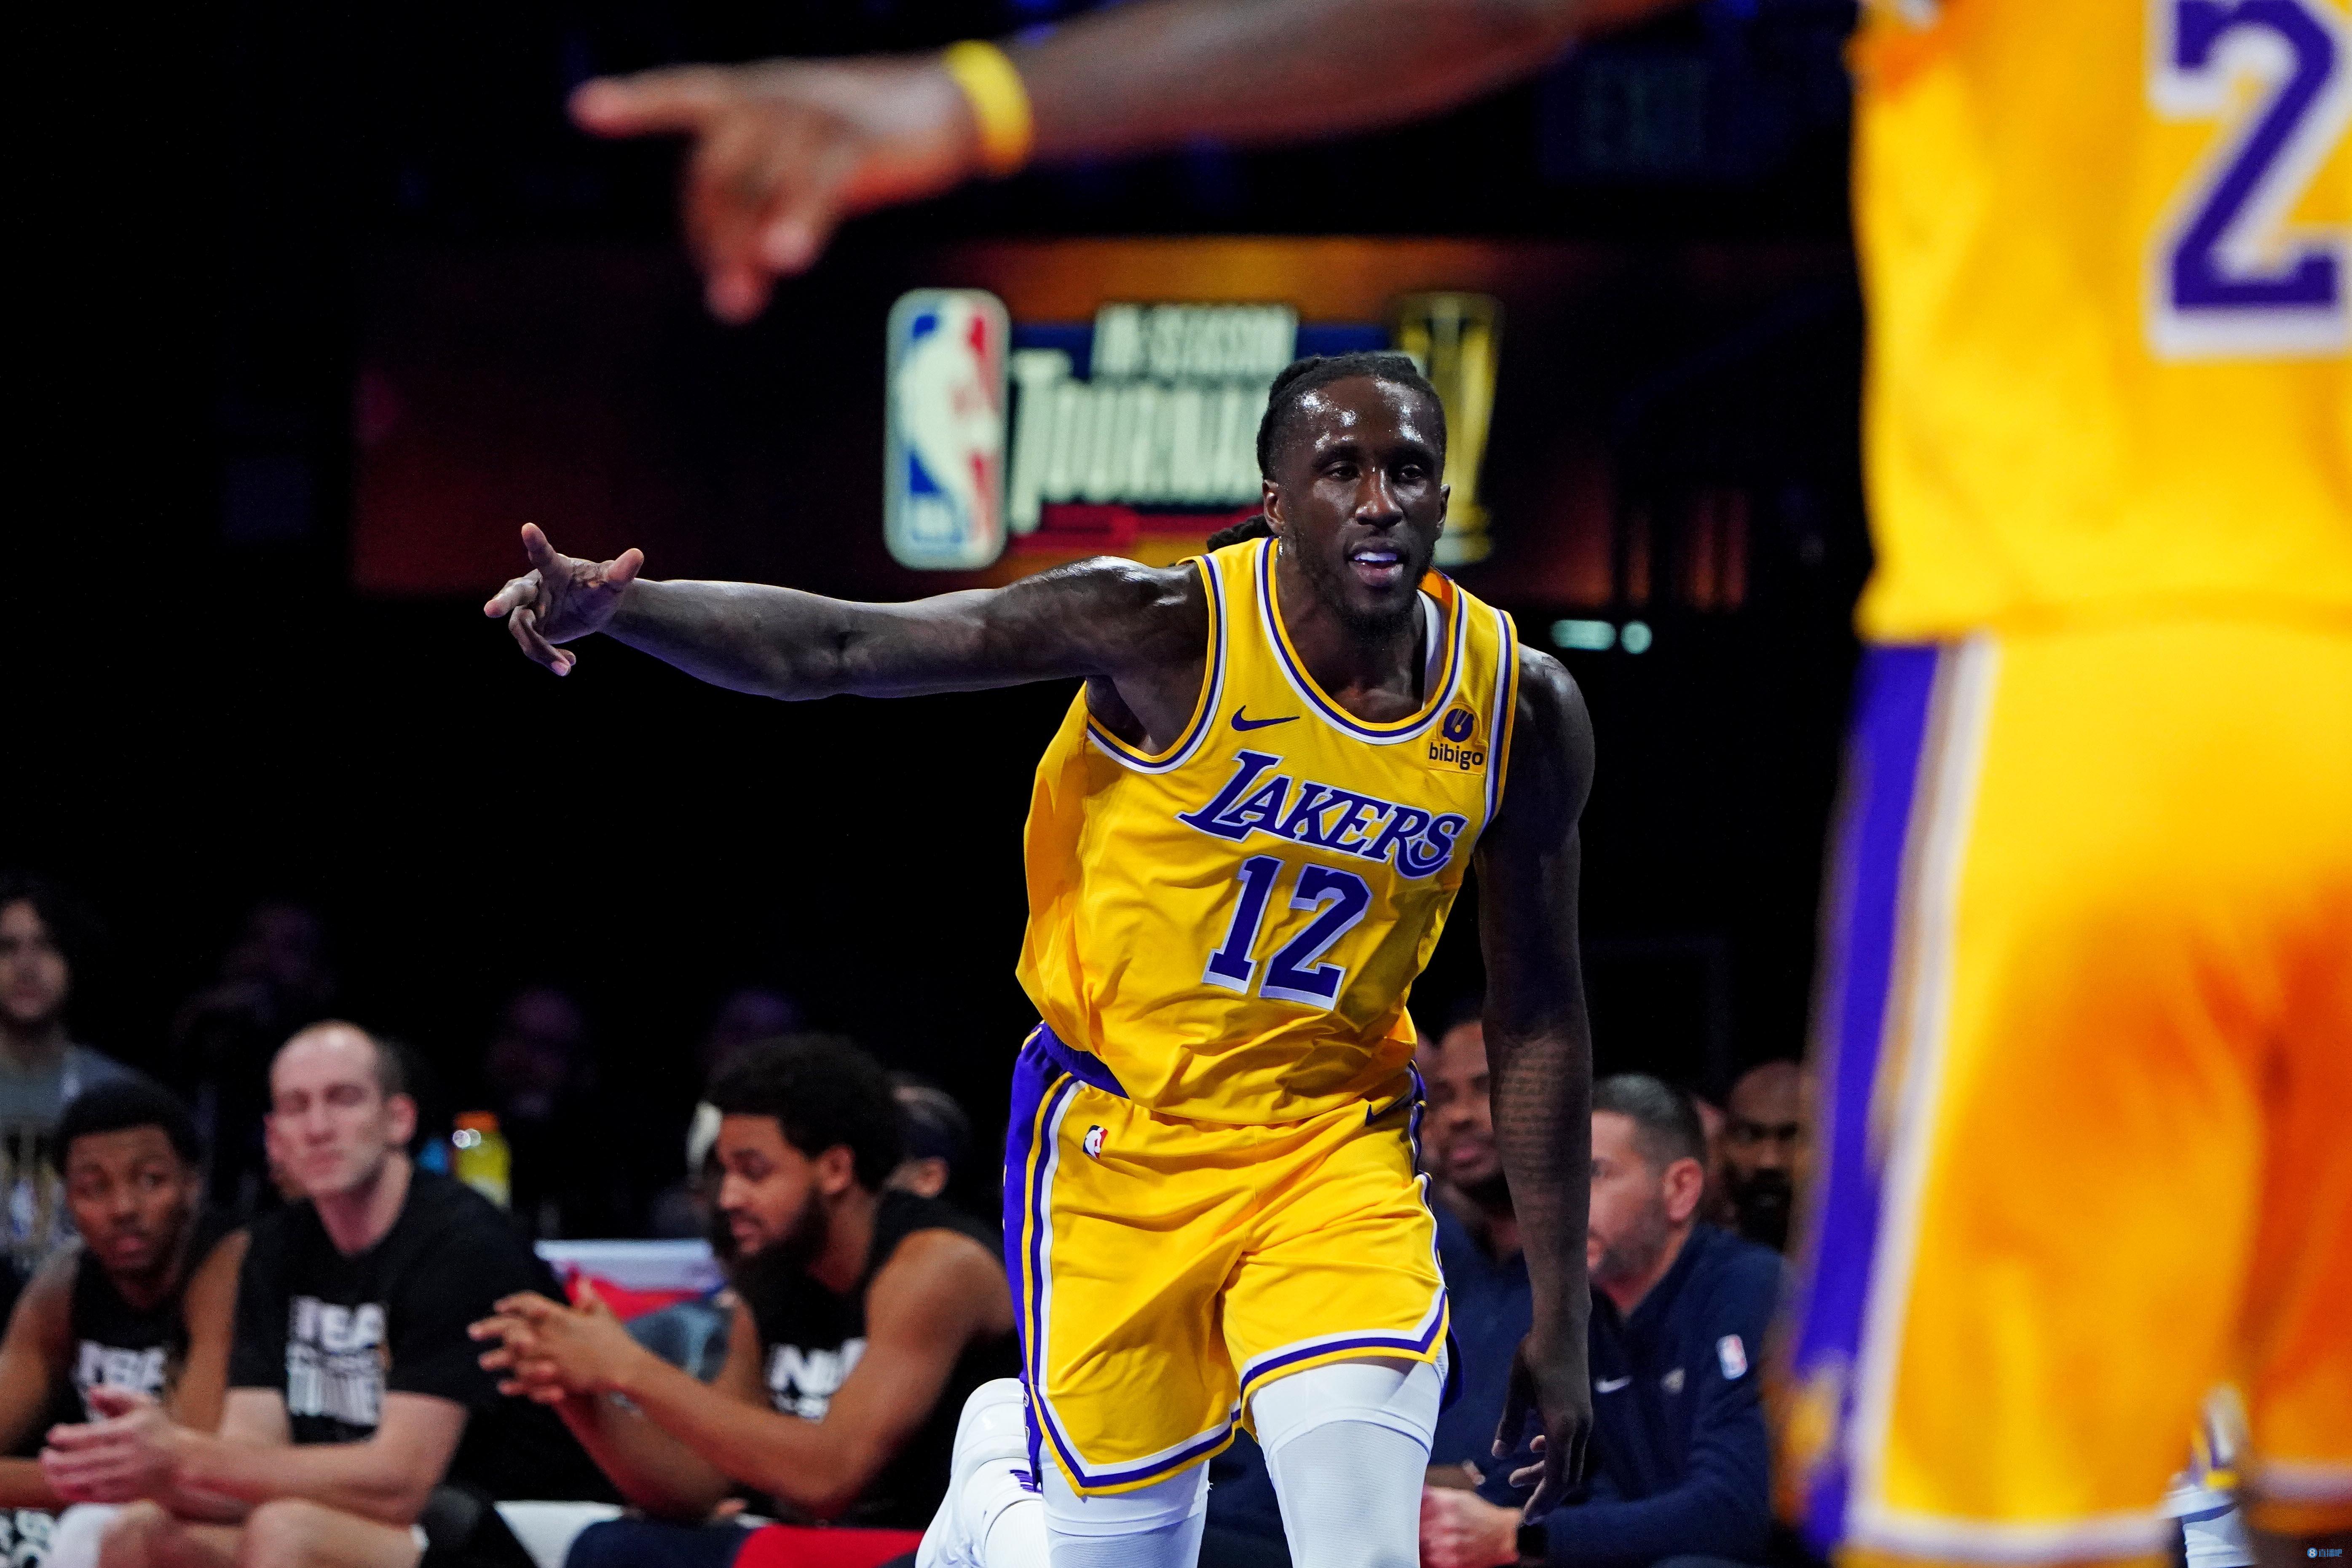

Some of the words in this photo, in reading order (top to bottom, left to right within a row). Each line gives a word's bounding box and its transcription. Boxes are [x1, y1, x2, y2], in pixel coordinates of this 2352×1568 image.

[1012, 349, 1266, 533] TOURNA
[1176, 749, 1468, 879] LAKERS
[1429, 742, 1484, 770] bibigo
[1202, 855, 1374, 1011] 12
